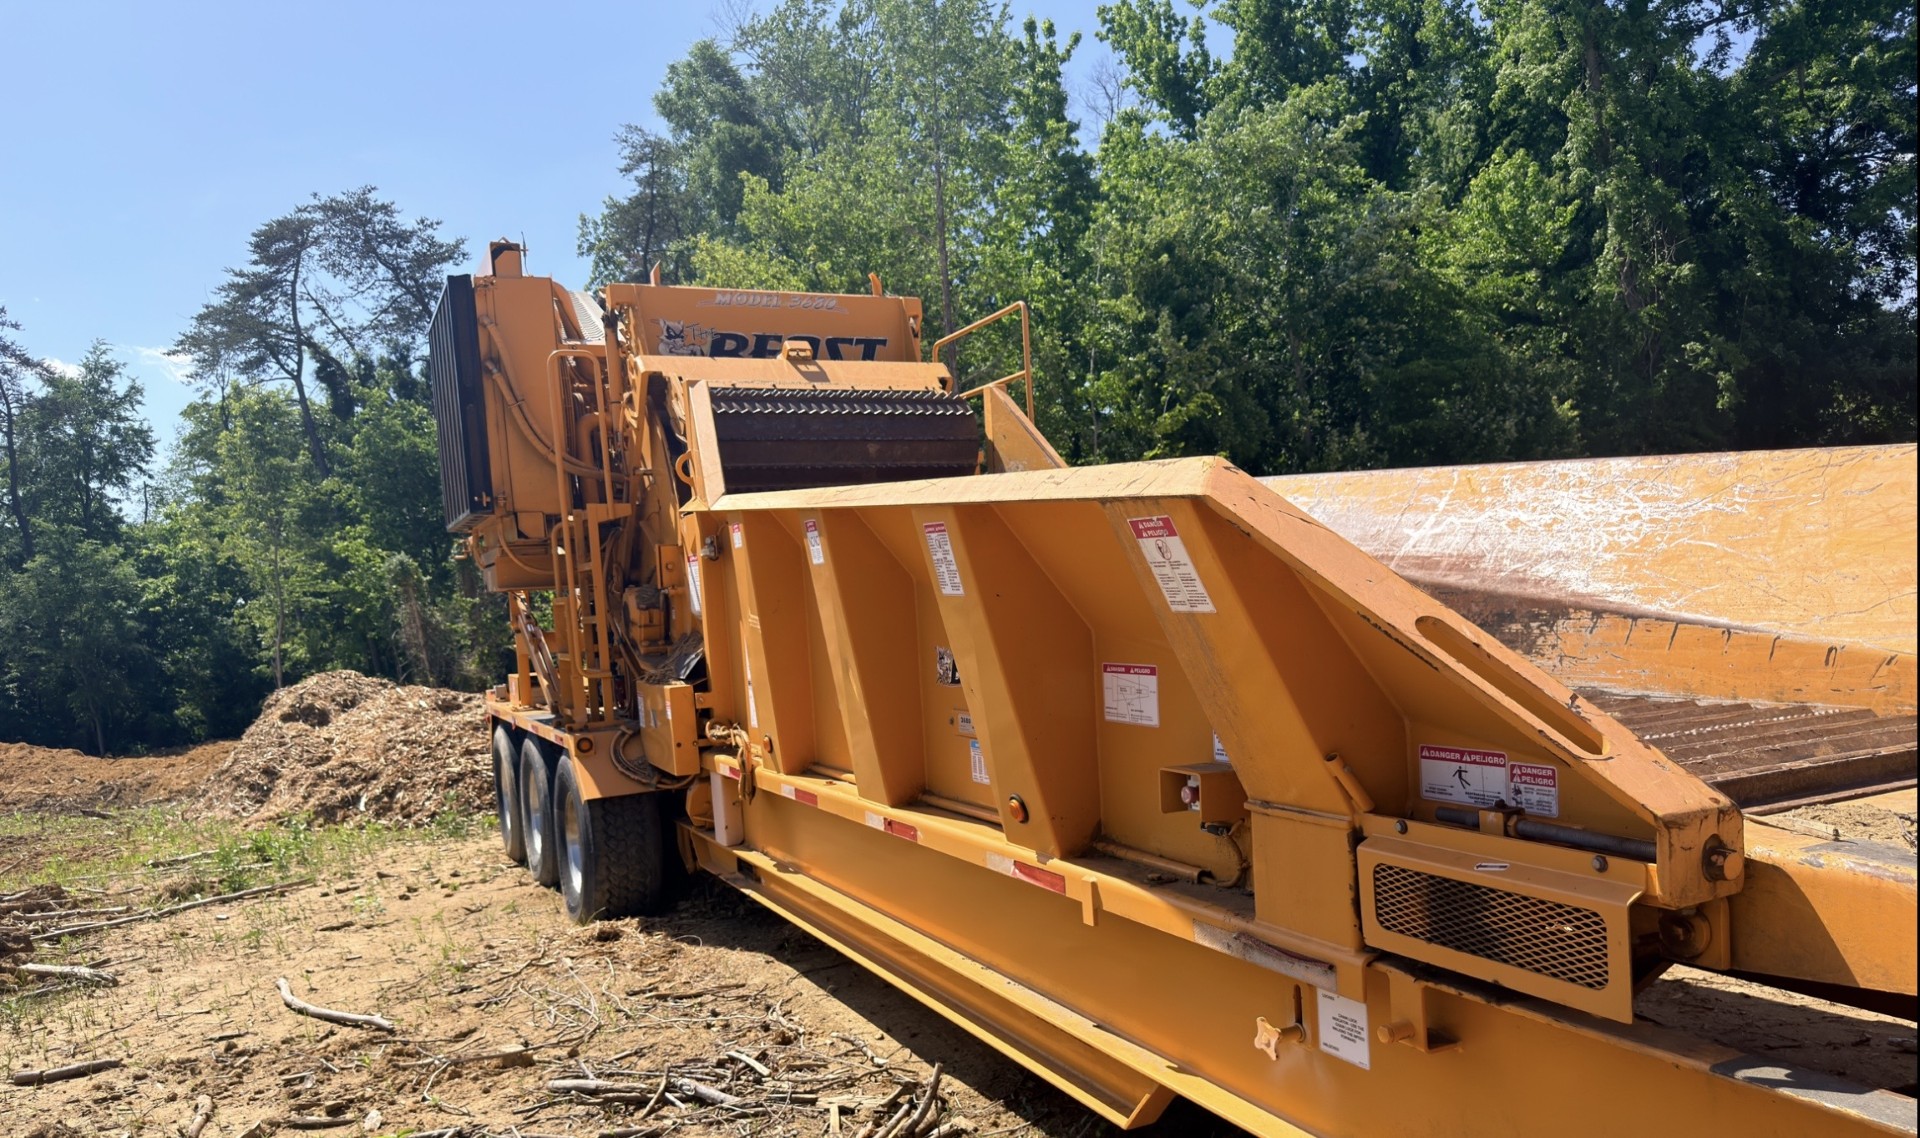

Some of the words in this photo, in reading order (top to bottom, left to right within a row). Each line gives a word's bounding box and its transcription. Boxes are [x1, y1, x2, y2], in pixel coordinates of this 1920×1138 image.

[714, 292, 781, 307] MODEL
[788, 295, 837, 310] 3680
[1430, 750, 1461, 760] DANGER
[1470, 755, 1505, 765] PELIGRO
[1521, 766, 1553, 776] DANGER
[1521, 775, 1554, 786] PELIGRO
